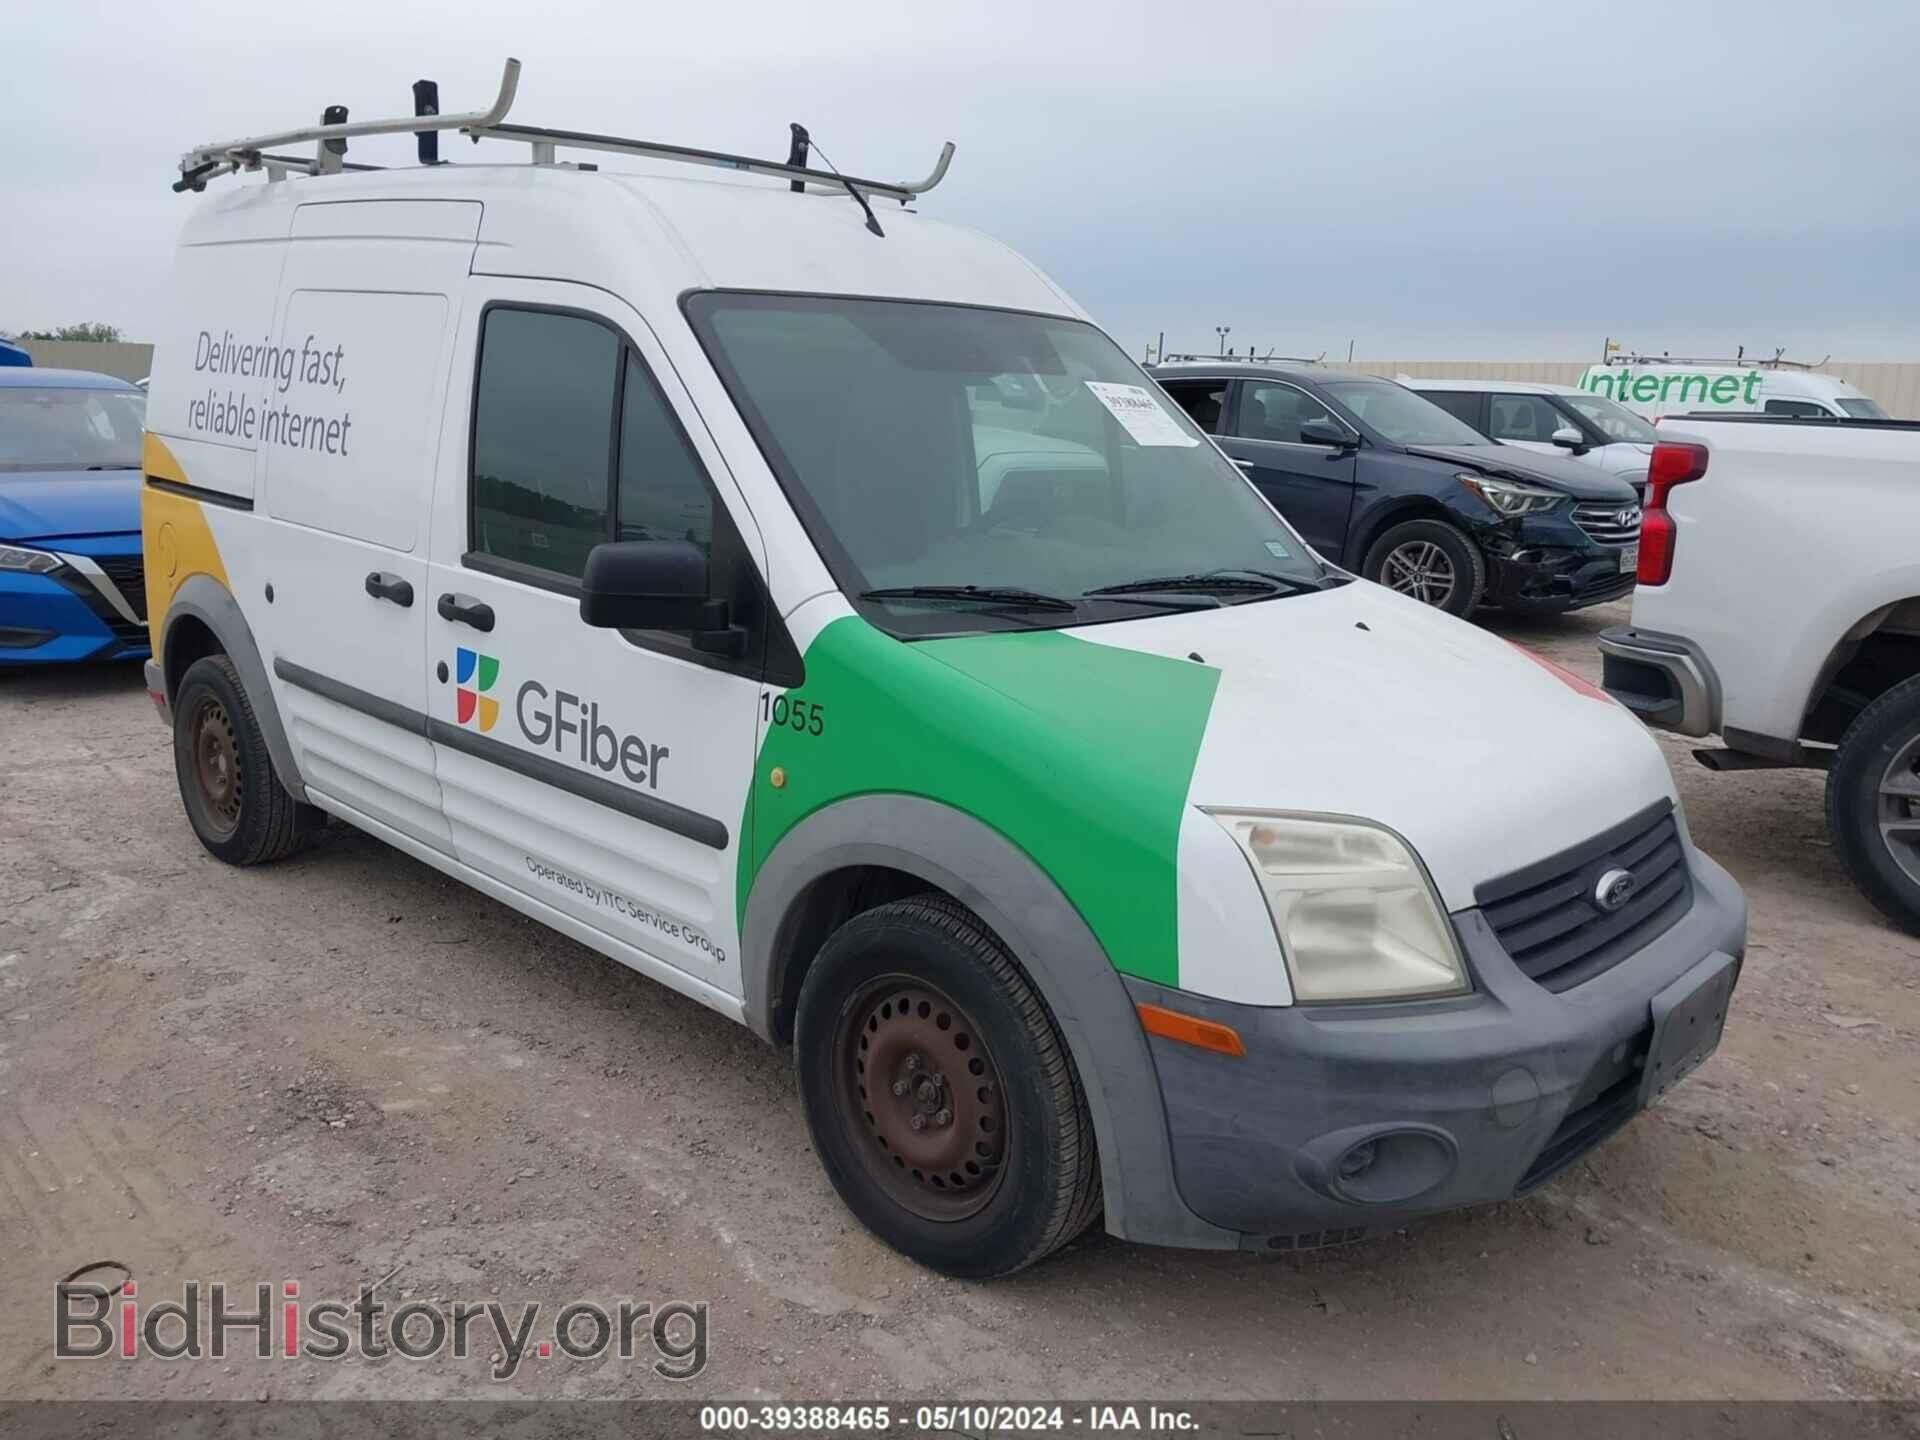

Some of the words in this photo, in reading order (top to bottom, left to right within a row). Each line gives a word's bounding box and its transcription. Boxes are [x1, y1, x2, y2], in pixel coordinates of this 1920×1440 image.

[194, 330, 295, 393] Delivering
[299, 334, 346, 394] fast,
[188, 388, 255, 438] reliable
[259, 399, 352, 456] internet
[516, 680, 669, 789] GFiber
[760, 691, 824, 737] 1055
[526, 856, 583, 894] Operated
[585, 884, 601, 905] by
[604, 890, 626, 913] ITC
[628, 901, 679, 937] Service
[682, 926, 726, 964] Group
